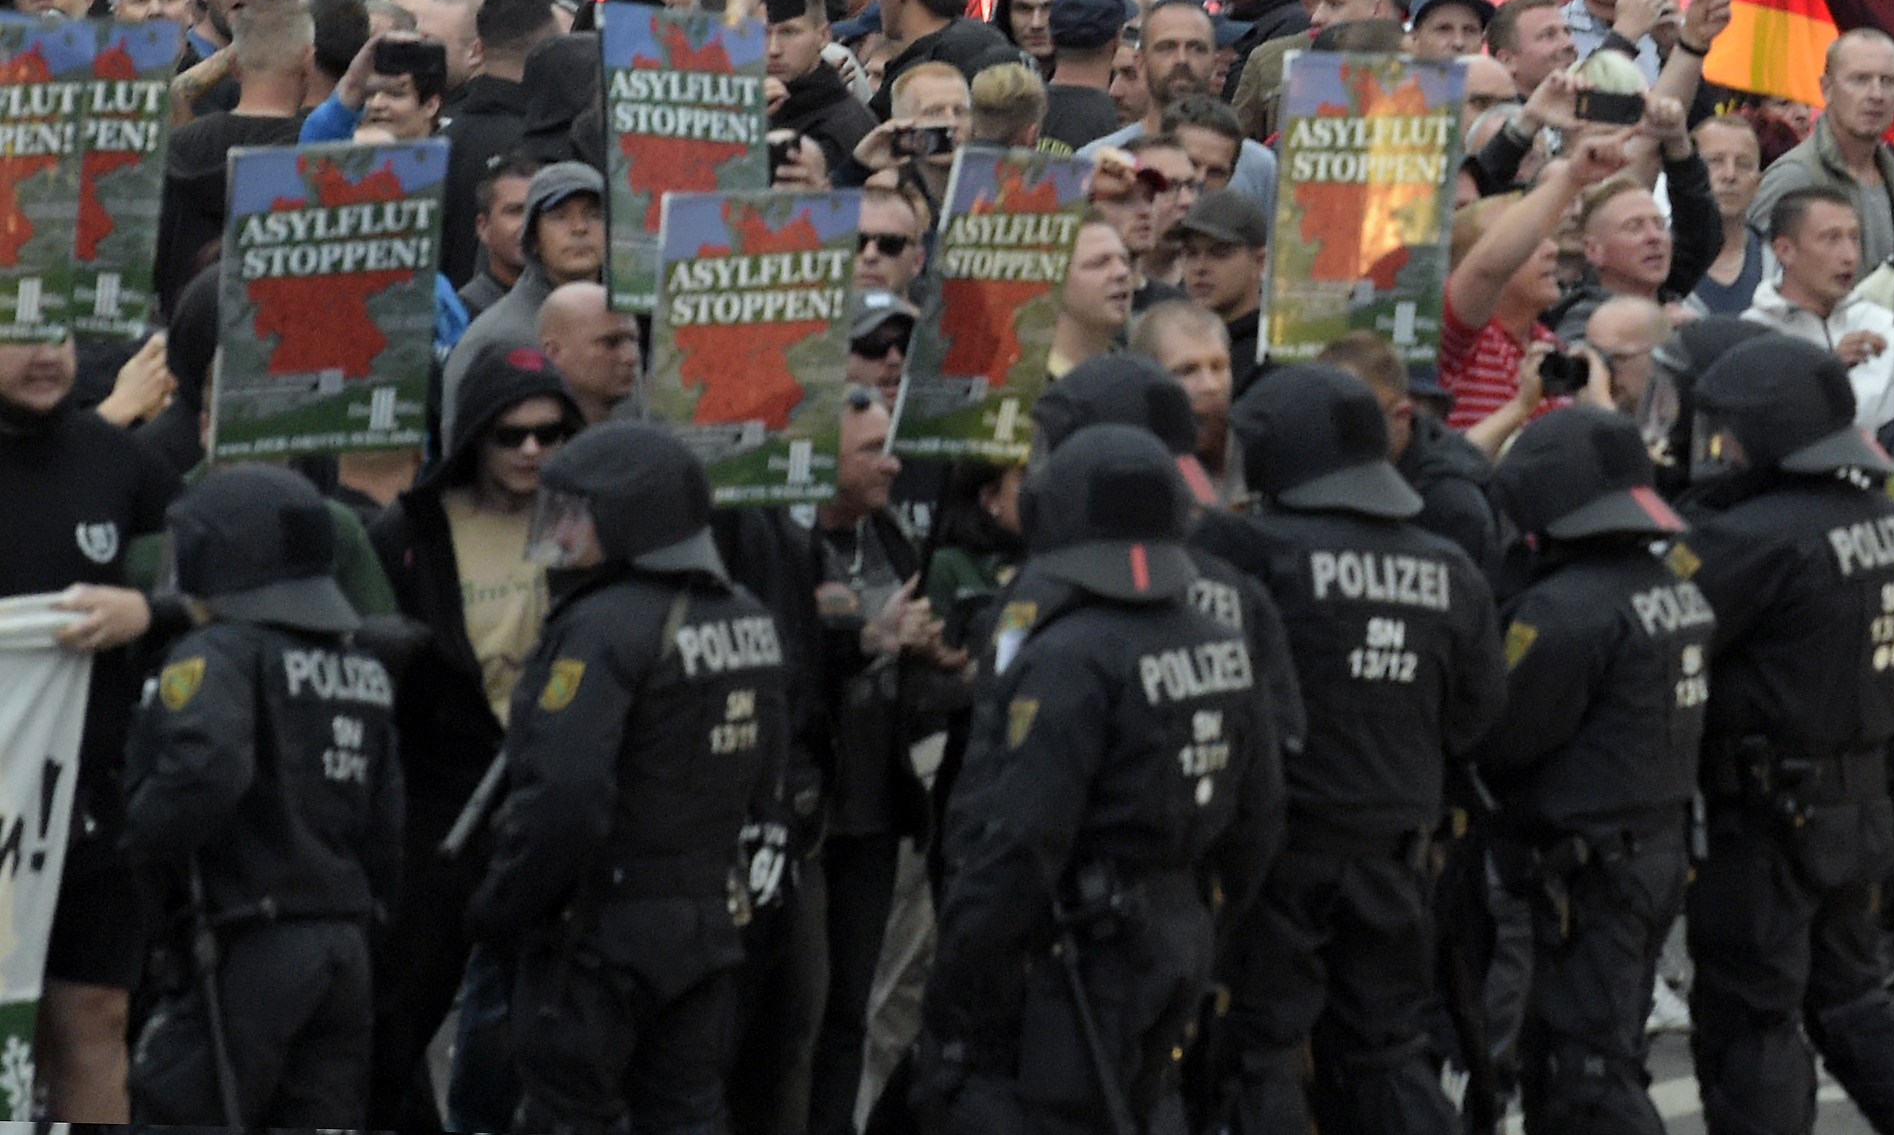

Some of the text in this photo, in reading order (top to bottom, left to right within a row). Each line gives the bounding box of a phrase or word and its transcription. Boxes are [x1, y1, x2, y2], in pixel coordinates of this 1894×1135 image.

[610, 69, 760, 107] ASYLFLUT
[614, 103, 760, 144] STOPPEN!
[1289, 115, 1455, 149] ASYLFLUT
[1291, 150, 1448, 184] STOPPEN!
[240, 198, 438, 245] ASYLFLUT
[946, 215, 1080, 246] ASYLFLUT
[243, 237, 432, 279] STOPPEN!
[668, 248, 851, 292] ASYLFLUT
[944, 247, 1069, 282] STOPPEN!
[670, 288, 846, 326] STOPPEN!
[1310, 550, 1450, 612] POLIZEI
[677, 615, 783, 678] POLIZEI
[1366, 617, 1406, 650] SN
[1139, 639, 1253, 706] POLIZEI
[1348, 647, 1419, 683] 13/12
